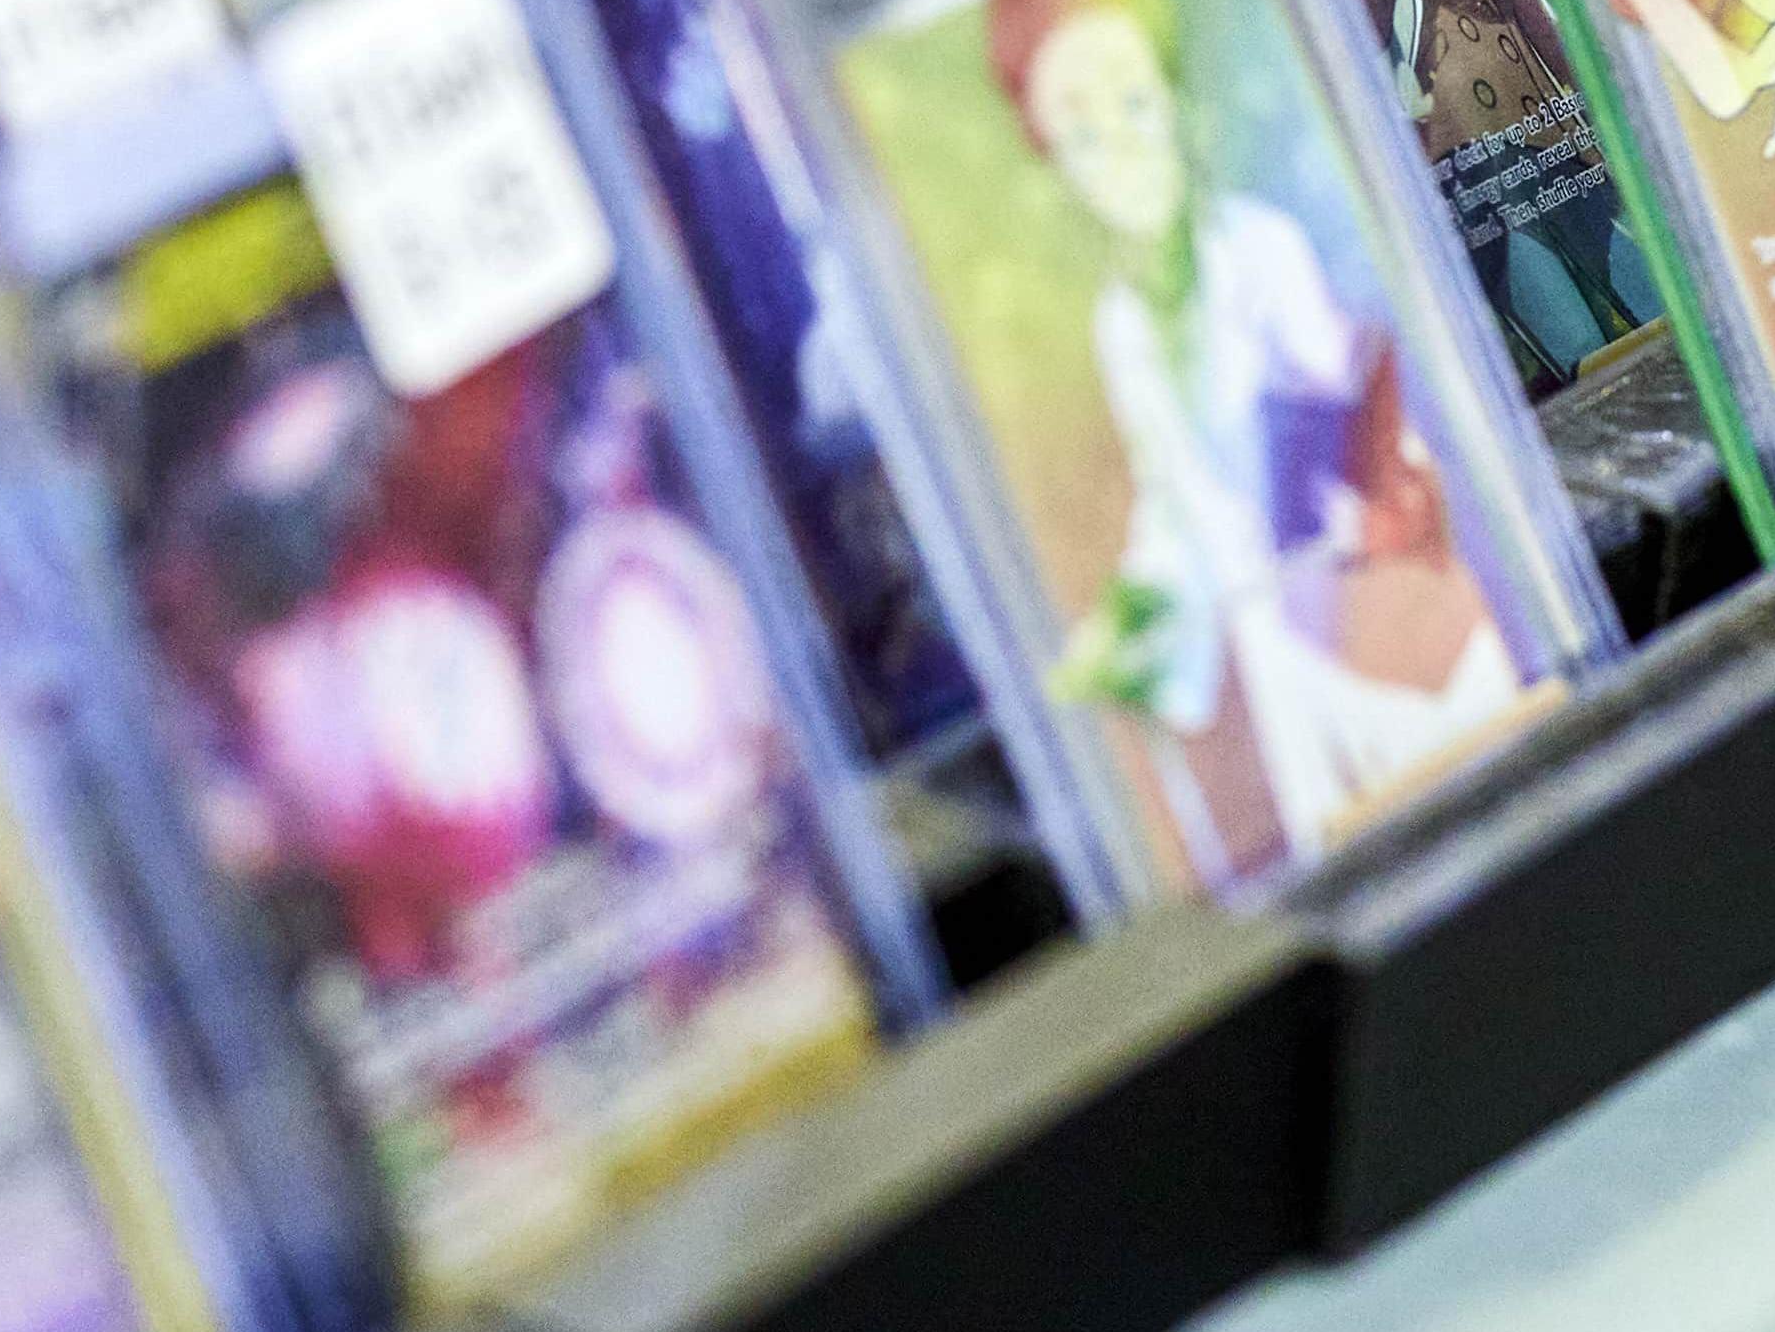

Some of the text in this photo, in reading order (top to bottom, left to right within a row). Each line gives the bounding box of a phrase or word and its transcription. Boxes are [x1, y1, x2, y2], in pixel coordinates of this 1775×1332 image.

[1506, 124, 1525, 148] up
[1524, 115, 1541, 135] to
[1539, 104, 1553, 127] 2
[1552, 93, 1586, 121] Basic
[1537, 133, 1576, 170] reveal
[1536, 174, 1578, 212] shuffle
[1576, 163, 1606, 199] your
